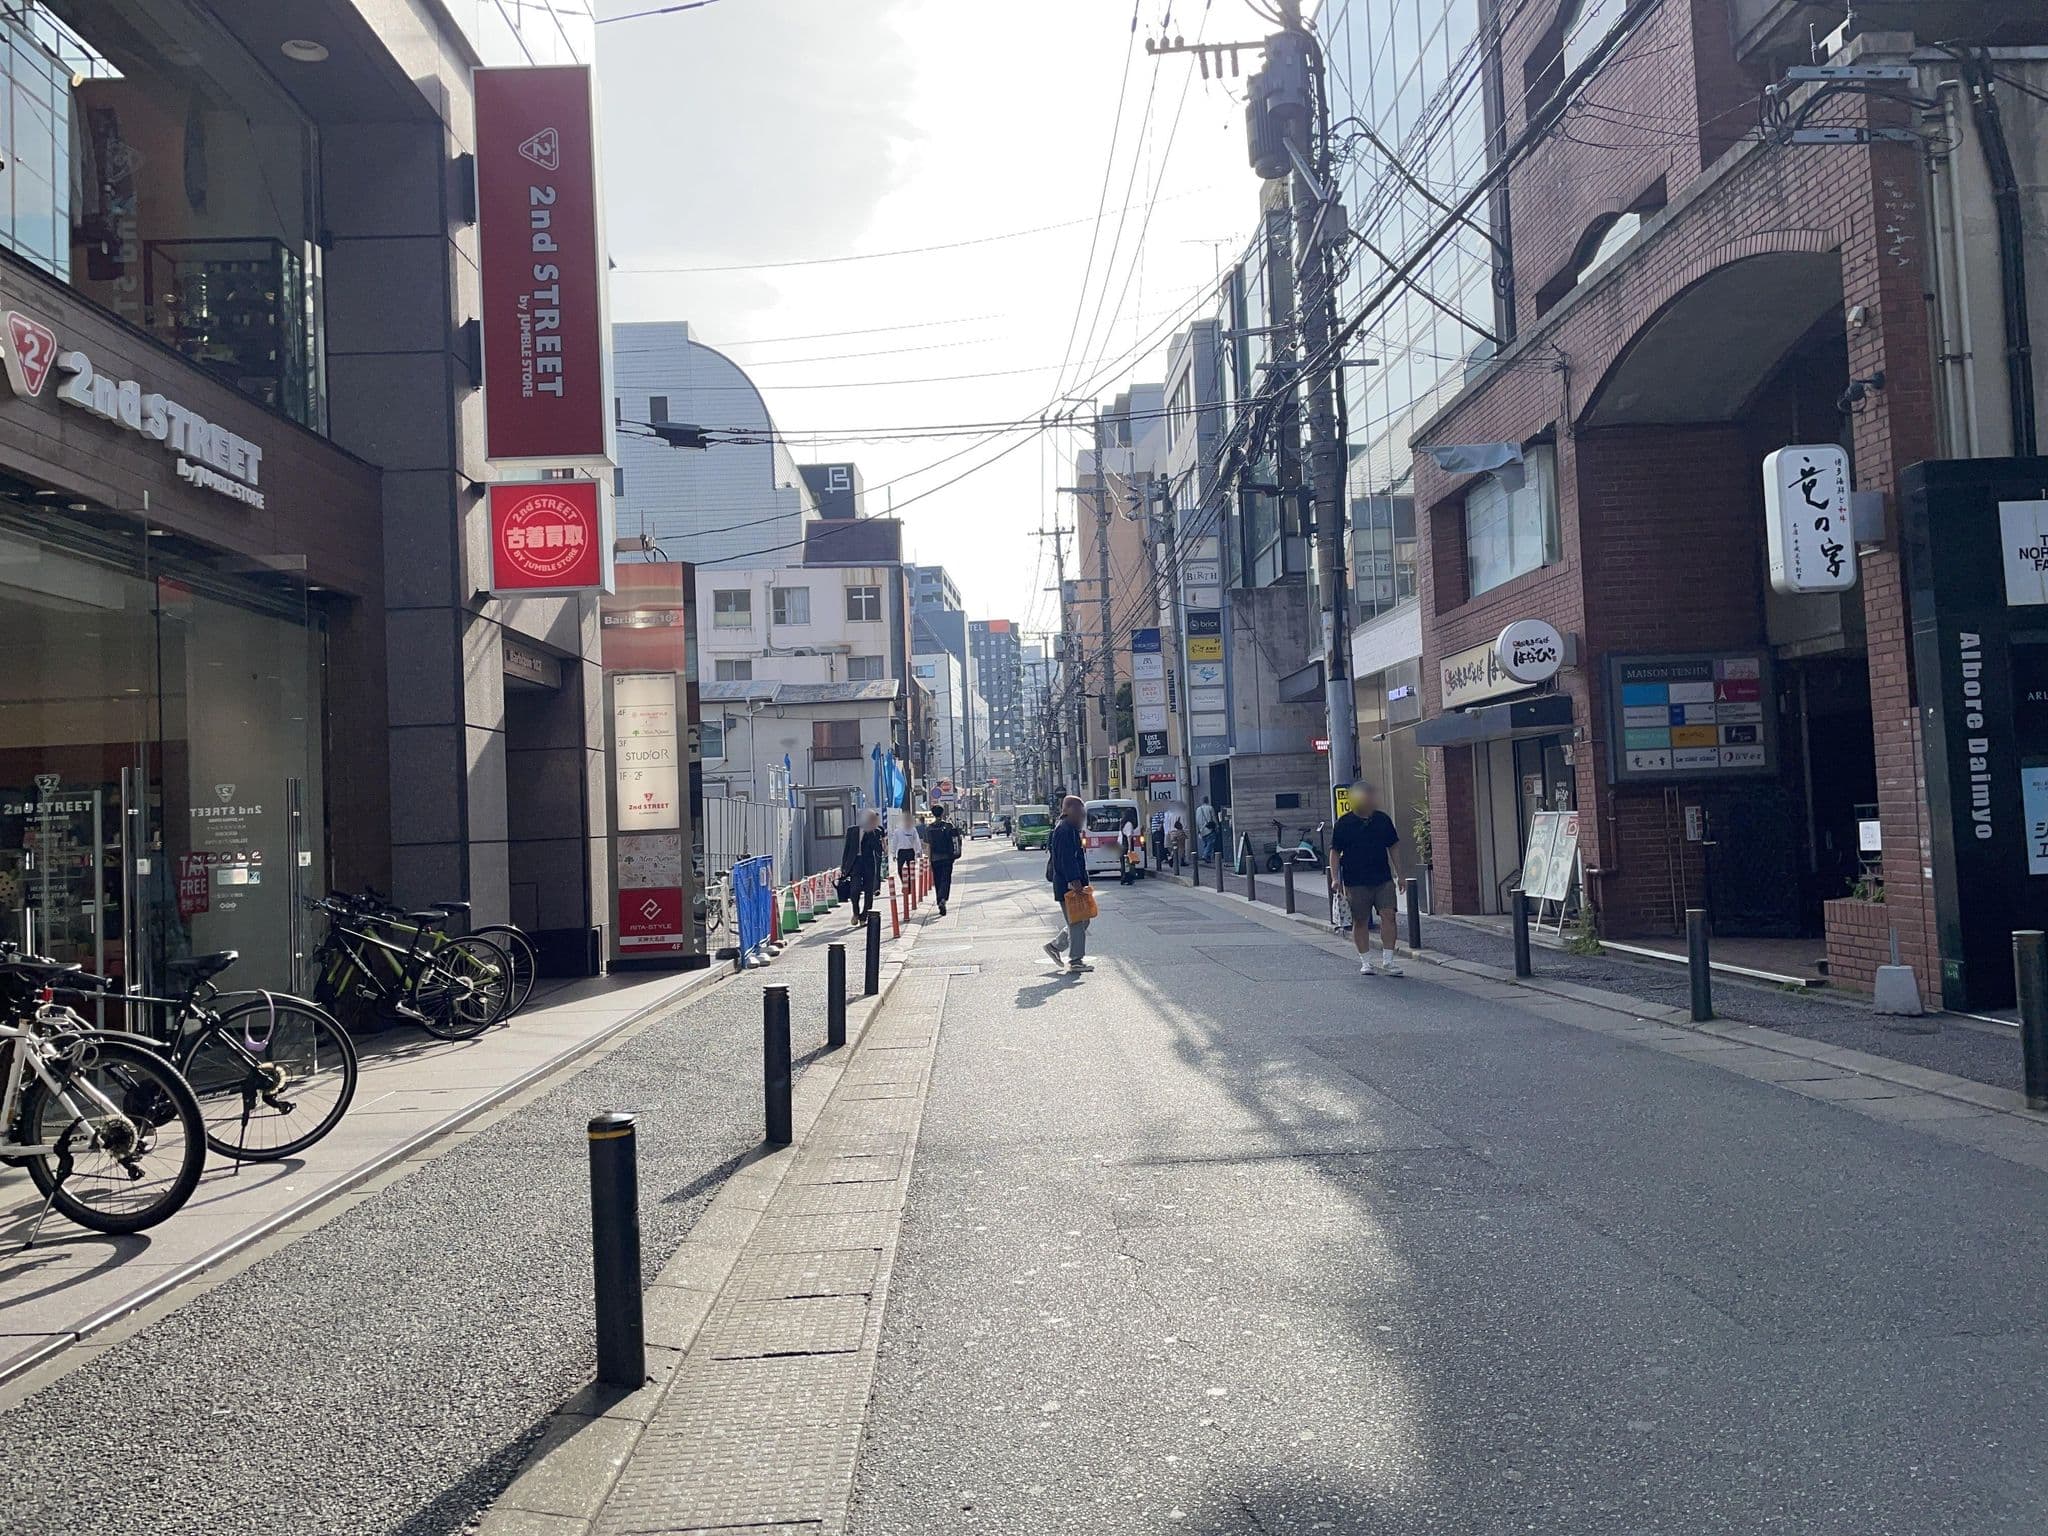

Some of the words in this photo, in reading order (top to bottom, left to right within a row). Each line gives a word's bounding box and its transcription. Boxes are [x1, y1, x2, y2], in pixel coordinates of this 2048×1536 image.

[528, 185, 559, 252] 2nd
[518, 295, 530, 311] by
[518, 313, 534, 358] JUMBLE
[533, 263, 564, 398] STREET
[520, 359, 534, 398] STORE
[56, 351, 142, 431] 2nd
[141, 393, 263, 486] STREET
[512, 502, 534, 523] 2nd
[534, 498, 578, 521] STREET
[506, 525, 584, 549] 古着買取
[513, 550, 526, 561] BY
[523, 560, 558, 572] JUMBLE
[556, 548, 579, 569] STORE
[1186, 571, 1217, 581] BIRTH
[1513, 647, 1556, 667] はなび
[1627, 669, 1668, 679] MAISON
[1672, 666, 1708, 677] TENJIN
[1959, 632, 1984, 729] Albore
[1968, 737, 1993, 840] Daimyo
[4, 803, 34, 815] 2nd
[37, 801, 92, 813] STREET
[180, 879, 207, 896] FREE
